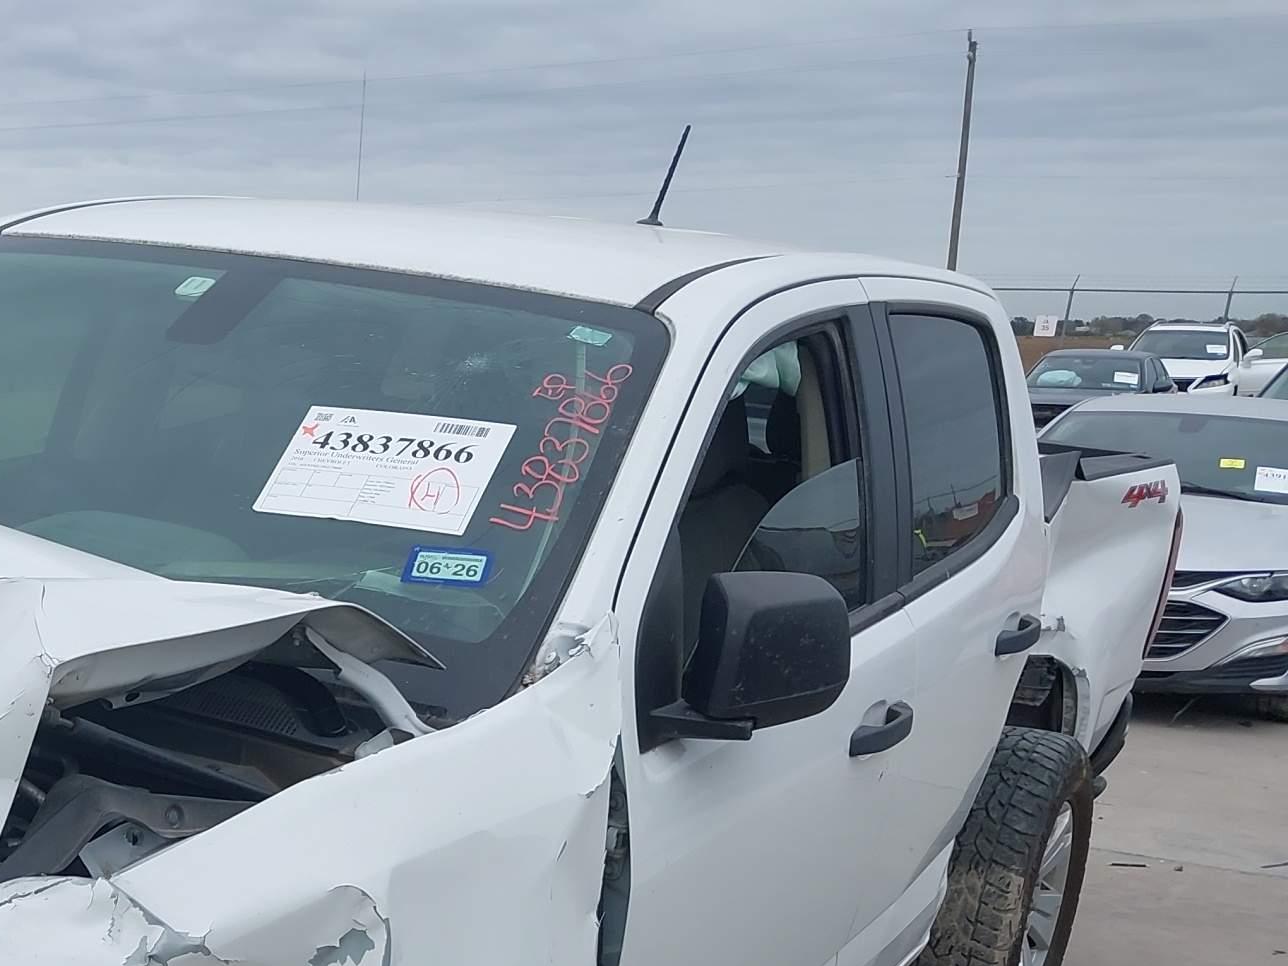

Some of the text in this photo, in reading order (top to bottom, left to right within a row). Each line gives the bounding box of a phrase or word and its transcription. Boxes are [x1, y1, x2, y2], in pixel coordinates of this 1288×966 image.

[312, 430, 480, 464] 43837866
[293, 448, 419, 466] Superior Underwriters General
[416, 561, 479, 578] 06 26
